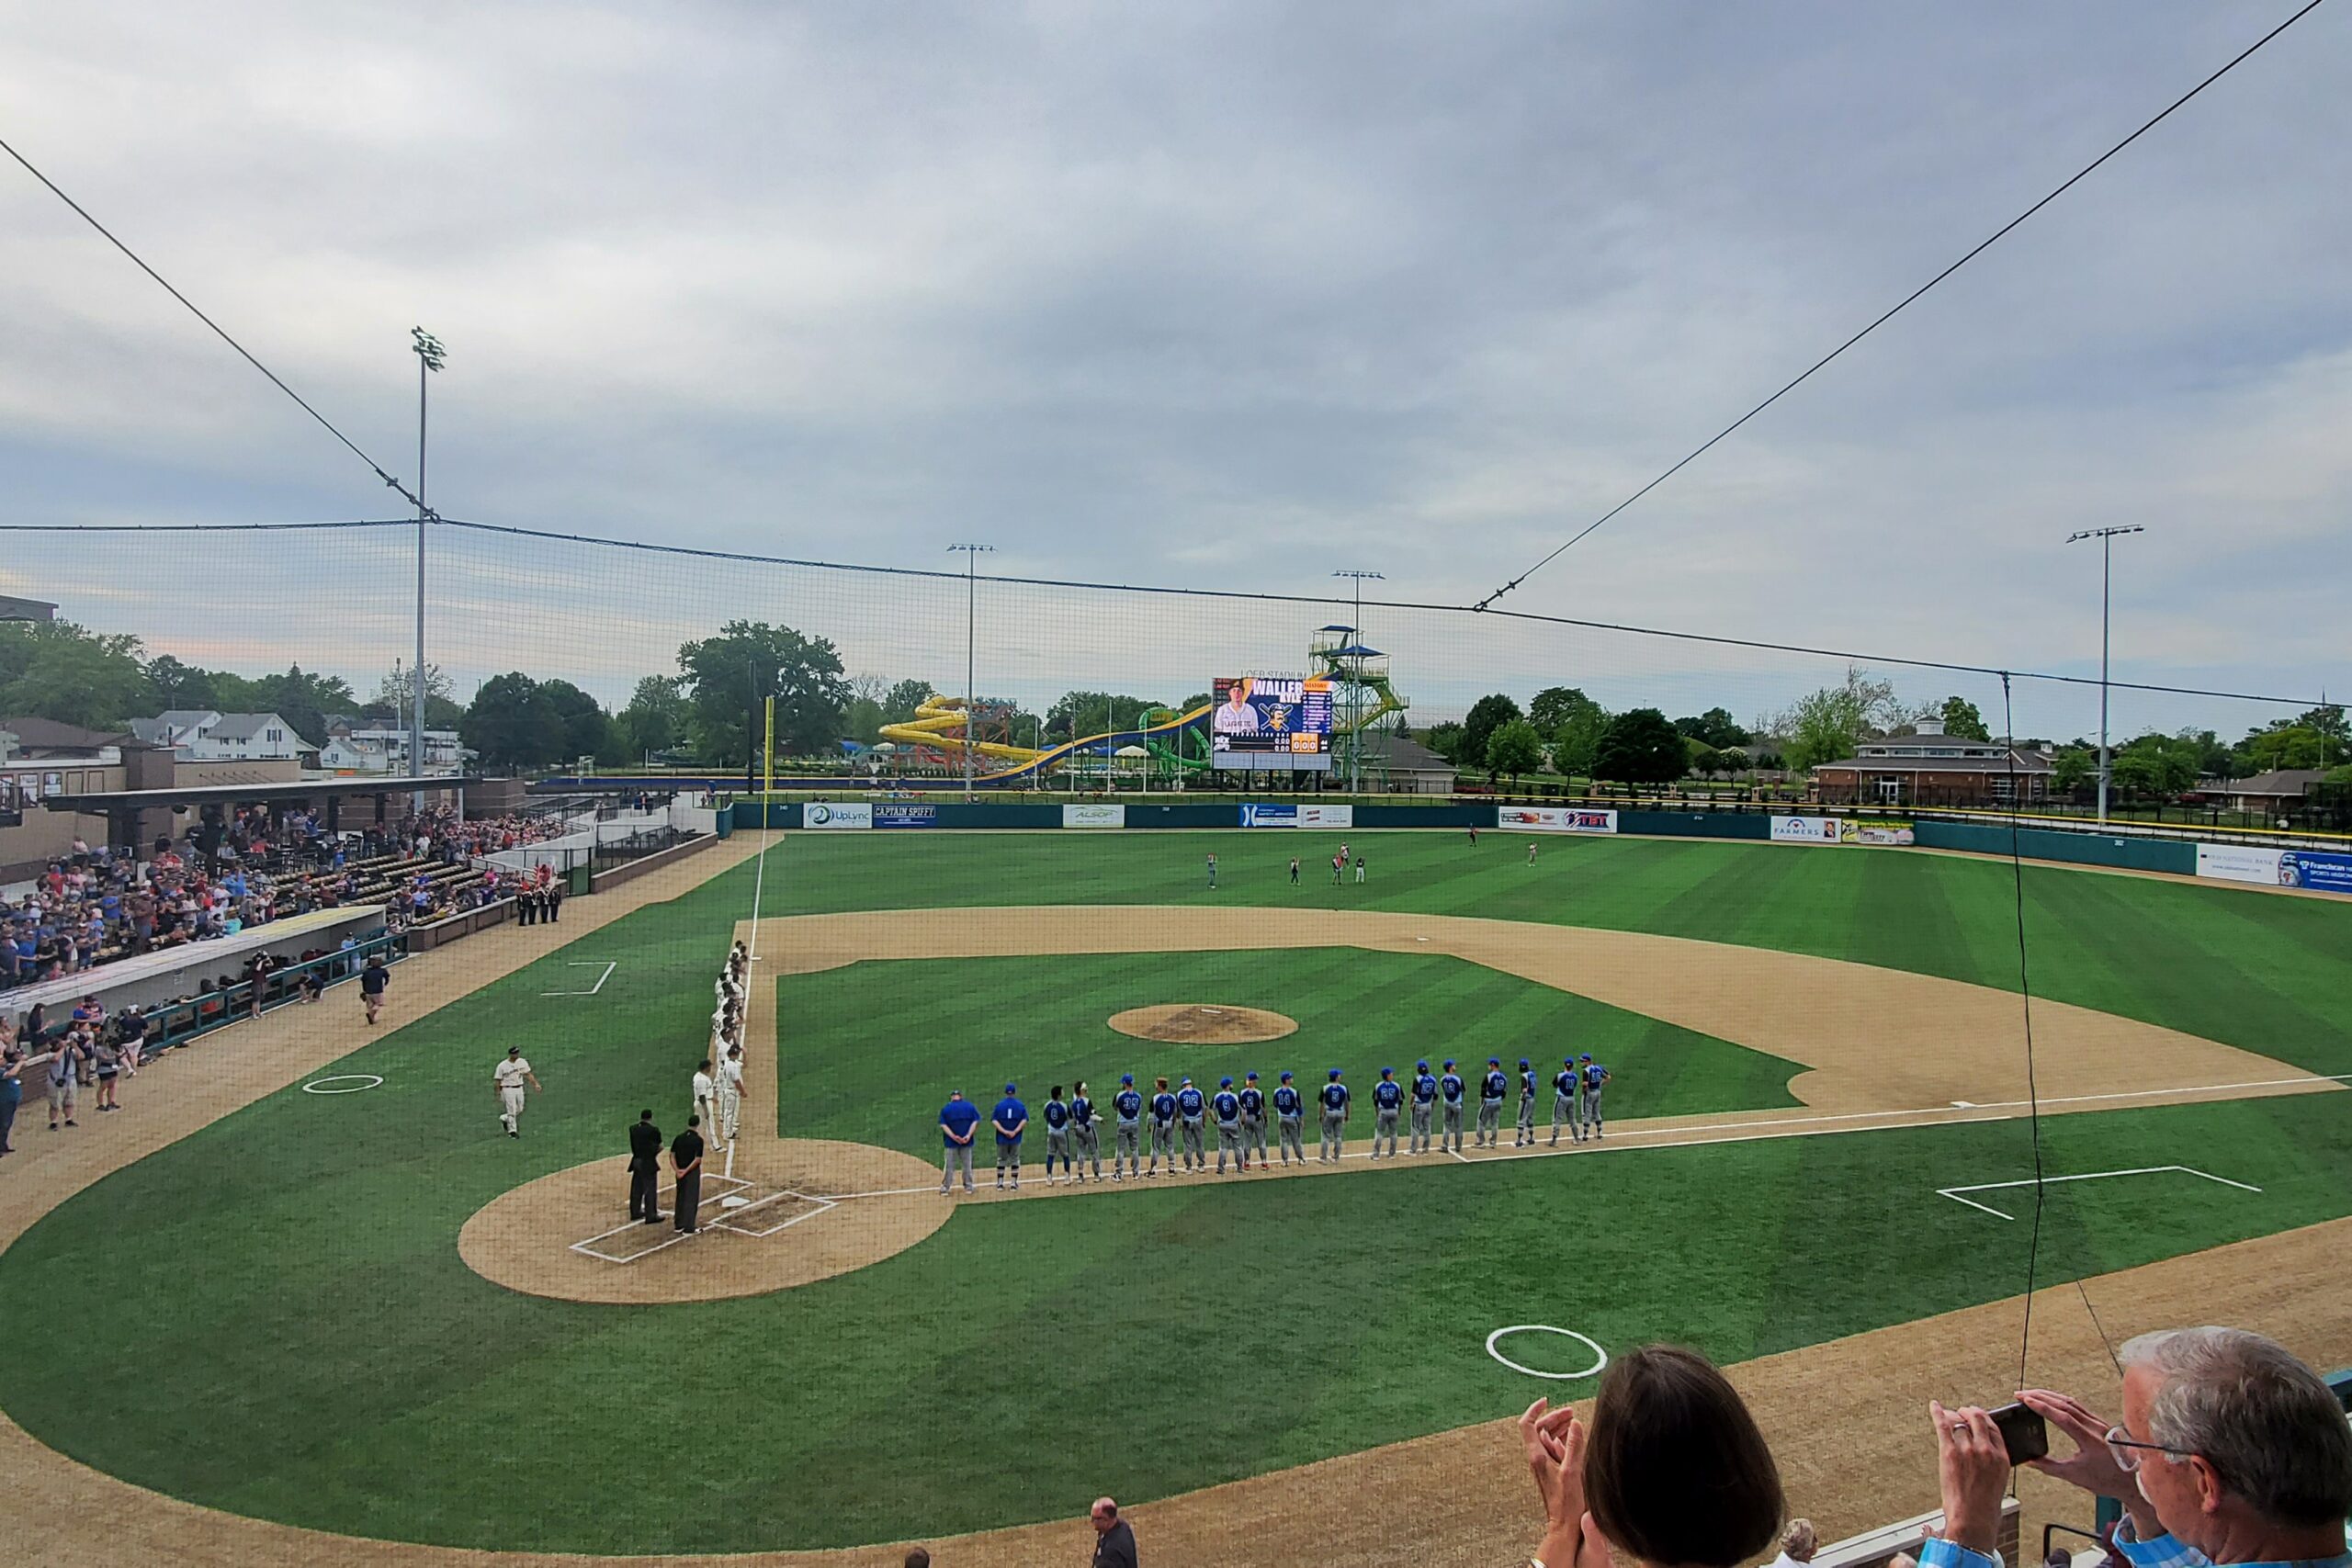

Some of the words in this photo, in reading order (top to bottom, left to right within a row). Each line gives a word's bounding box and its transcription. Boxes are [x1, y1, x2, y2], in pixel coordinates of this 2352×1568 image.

[1267, 671, 1306, 679] STADIUM
[1253, 680, 1304, 695] WALLER
[1279, 694, 1302, 704] KYLE
[1294, 741, 1300, 750] 0
[1302, 741, 1308, 750] 0
[1309, 741, 1316, 750] 0
[835, 812, 870, 821] UpLync
[875, 807, 908, 817] CAPTAIN
[908, 807, 935, 817] SPIFFY
[1774, 828, 1819, 836] FARMERS
[2255, 858, 2274, 866] BANK
[2310, 862, 2346, 872] Franciscan
[1278, 1092, 1291, 1106] 14
